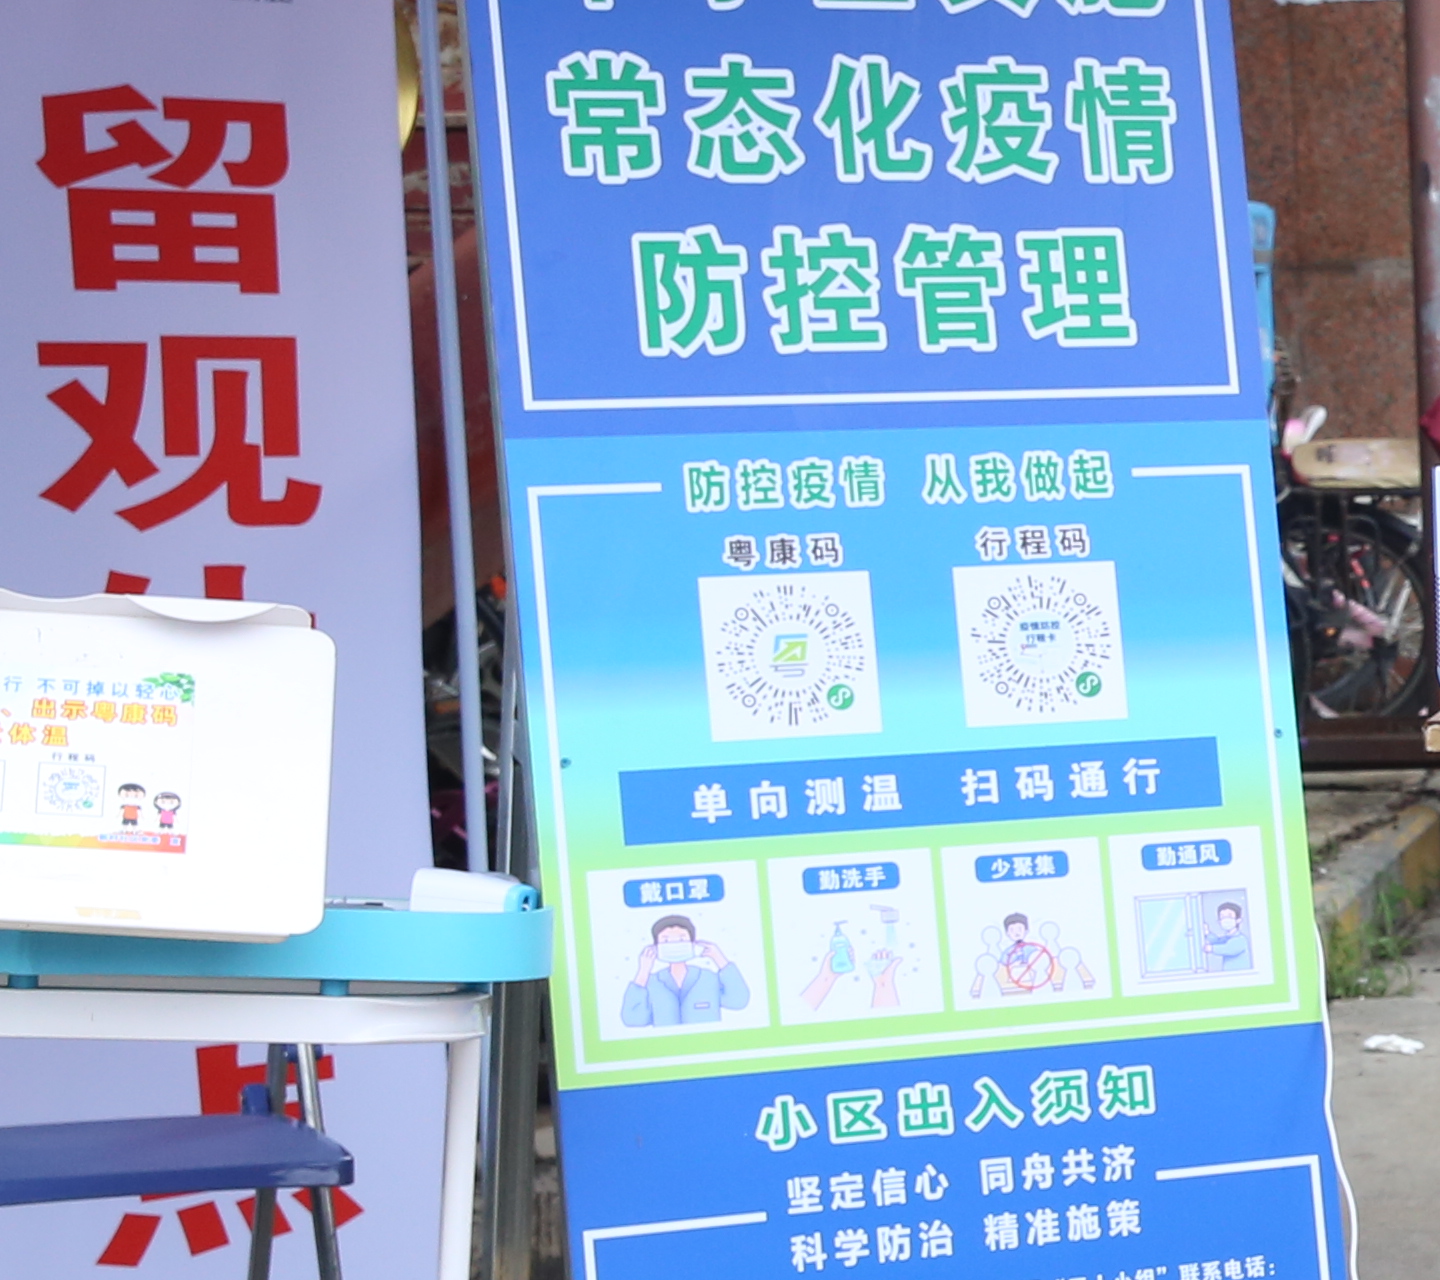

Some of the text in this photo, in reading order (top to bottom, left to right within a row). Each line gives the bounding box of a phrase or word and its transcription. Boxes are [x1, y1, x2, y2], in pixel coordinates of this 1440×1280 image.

[546, 50, 1178, 185] 常态化疫情
[632, 224, 1138, 357] 防控管理
[684, 449, 1115, 511] 防控疫情 从我做起
[724, 524, 1090, 569] 粤康码 行程码
[37, 678, 179, 700] 不可掉以轻心
[0, 722, 69, 746] 体温
[690, 757, 1162, 824] 单向测温 扫码通行
[639, 843, 1220, 903] 戴口罩 勤洗手 少聚集 勤通风
[755, 1065, 1157, 1151] 小区出入须知
[786, 1144, 1136, 1216] 坚定信心 同舟共济
[790, 1199, 1143, 1273] 科学防治 精准施策
